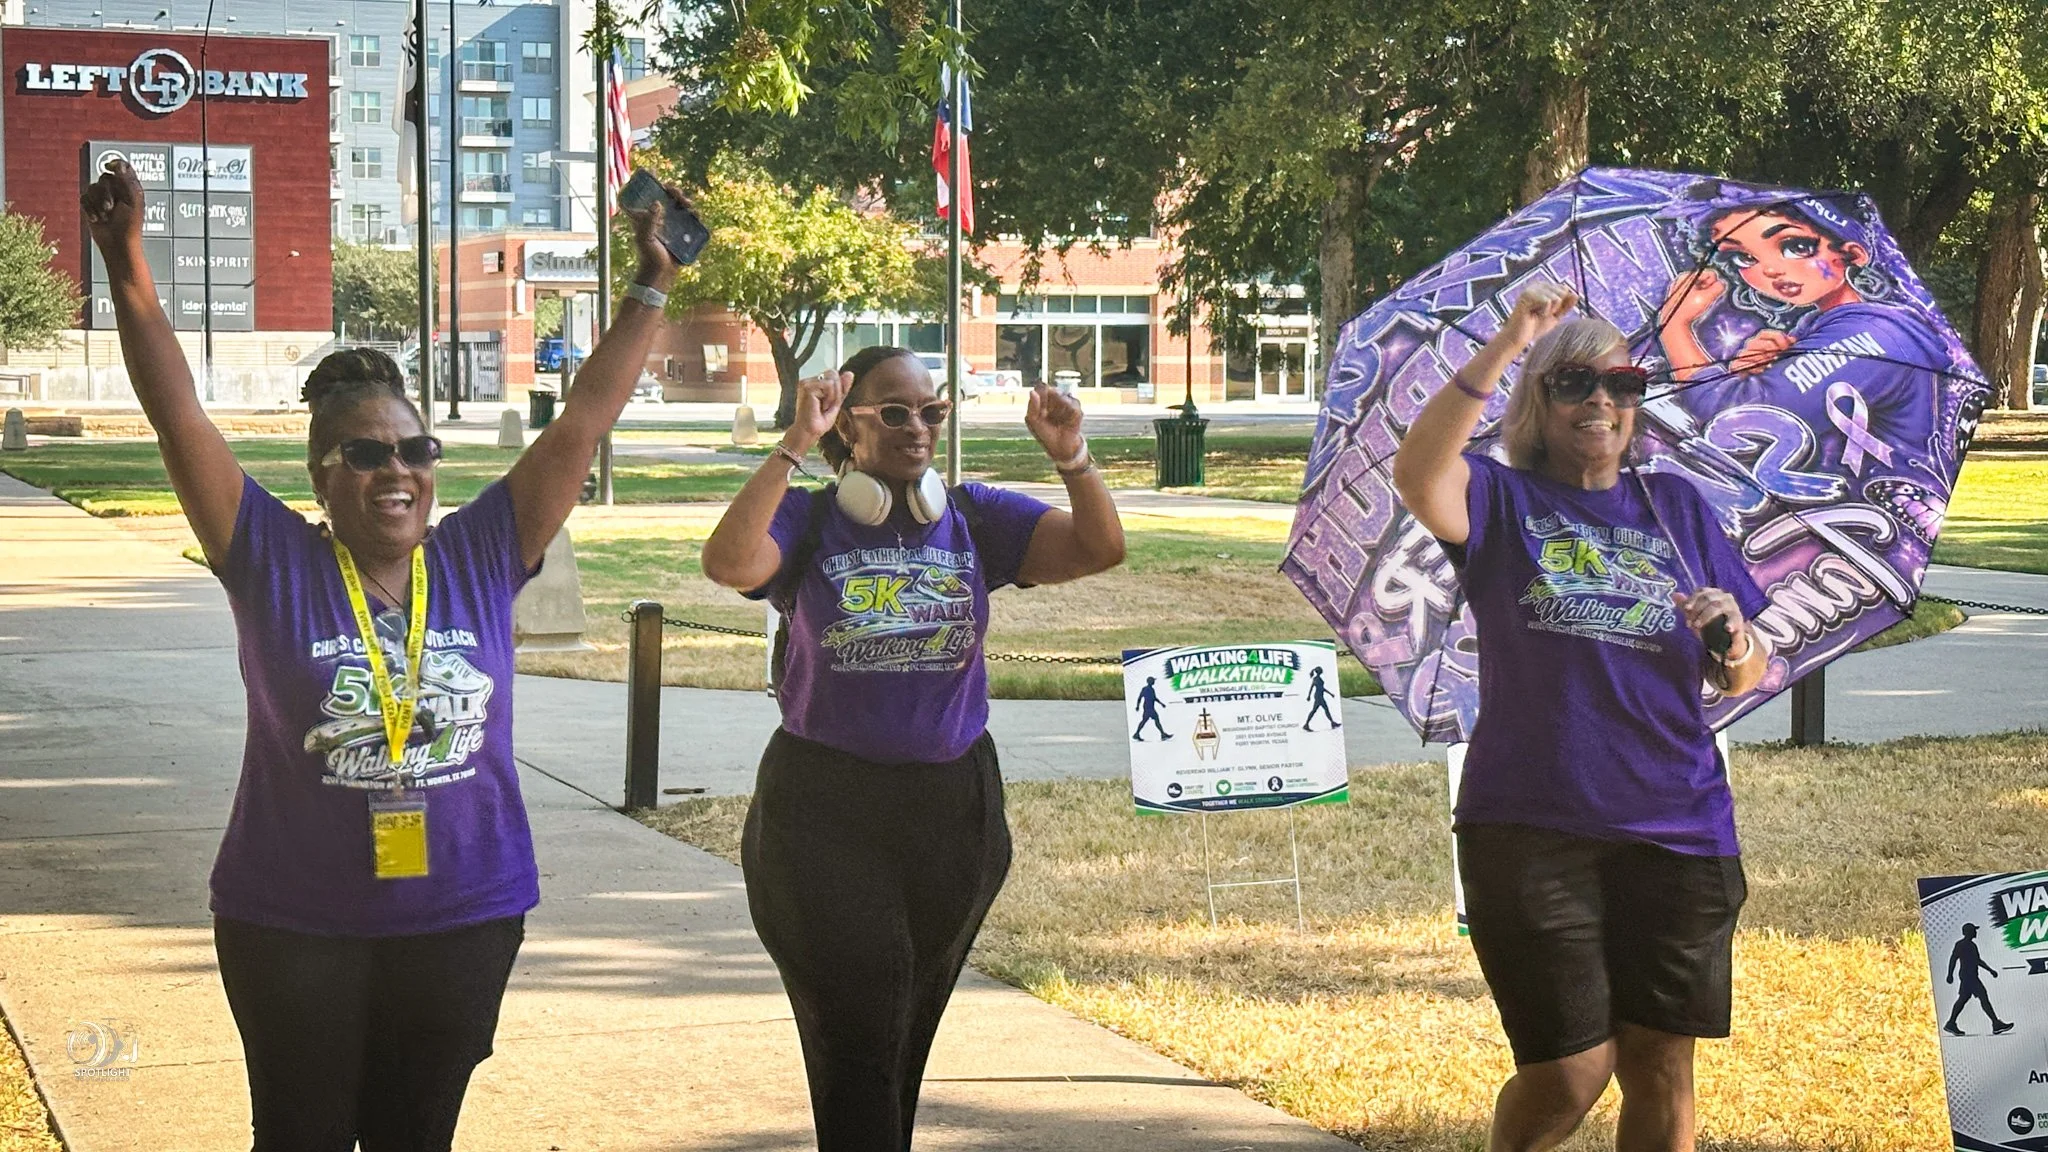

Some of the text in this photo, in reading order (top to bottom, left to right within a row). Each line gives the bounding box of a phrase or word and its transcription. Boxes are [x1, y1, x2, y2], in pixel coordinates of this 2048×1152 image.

[25, 63, 127, 92] LEFT
[197, 70, 309, 98] BANK
[130, 152, 165, 161] BUFFALO
[131, 160, 166, 172] WILD
[822, 548, 862, 575] CHRIST
[861, 546, 922, 568] CATHEDRAL
[1537, 538, 1613, 578] 5K
[838, 573, 914, 615] 5K
[906, 601, 976, 625] WALK
[1170, 650, 1294, 674] WALKING4LIFE
[1179, 664, 1287, 689] WALKATHON
[320, 664, 409, 718] 5K
[1237, 712, 1283, 723] MT. OLIVE
